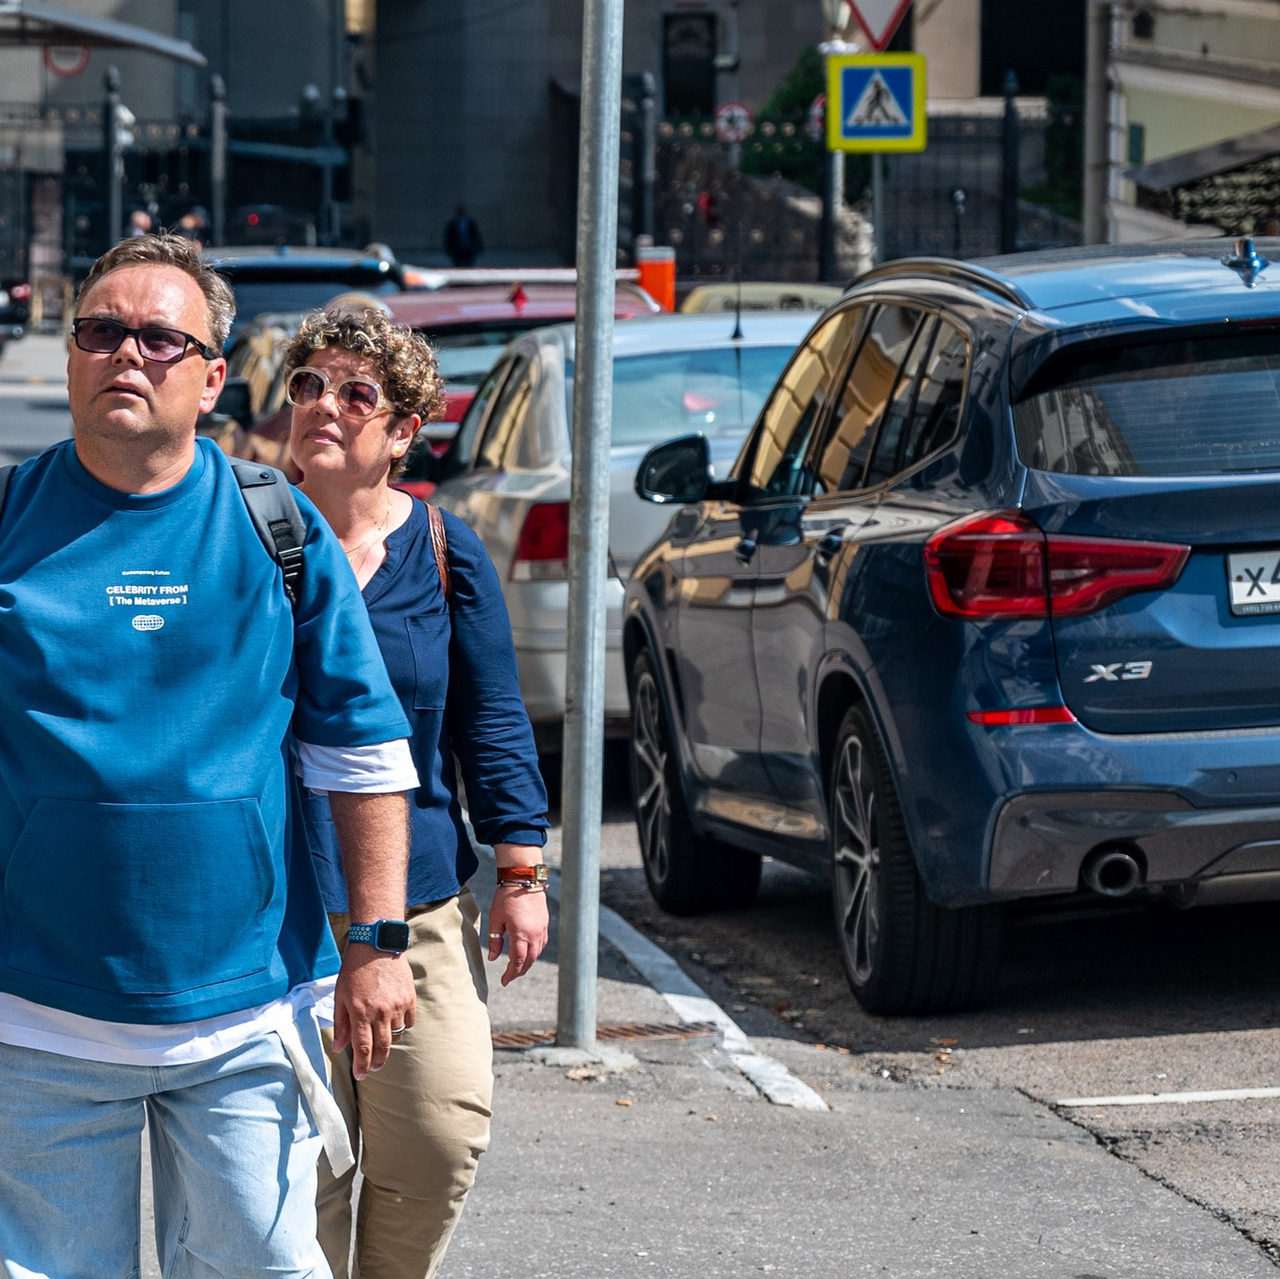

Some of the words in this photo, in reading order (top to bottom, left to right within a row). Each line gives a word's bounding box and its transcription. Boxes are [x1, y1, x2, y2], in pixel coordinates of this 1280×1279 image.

[106, 585, 158, 594] CELEBRITY
[160, 584, 188, 594] FROM
[115, 597, 133, 605] The
[134, 597, 181, 605] Metaverse
[1082, 660, 1153, 683] X3
